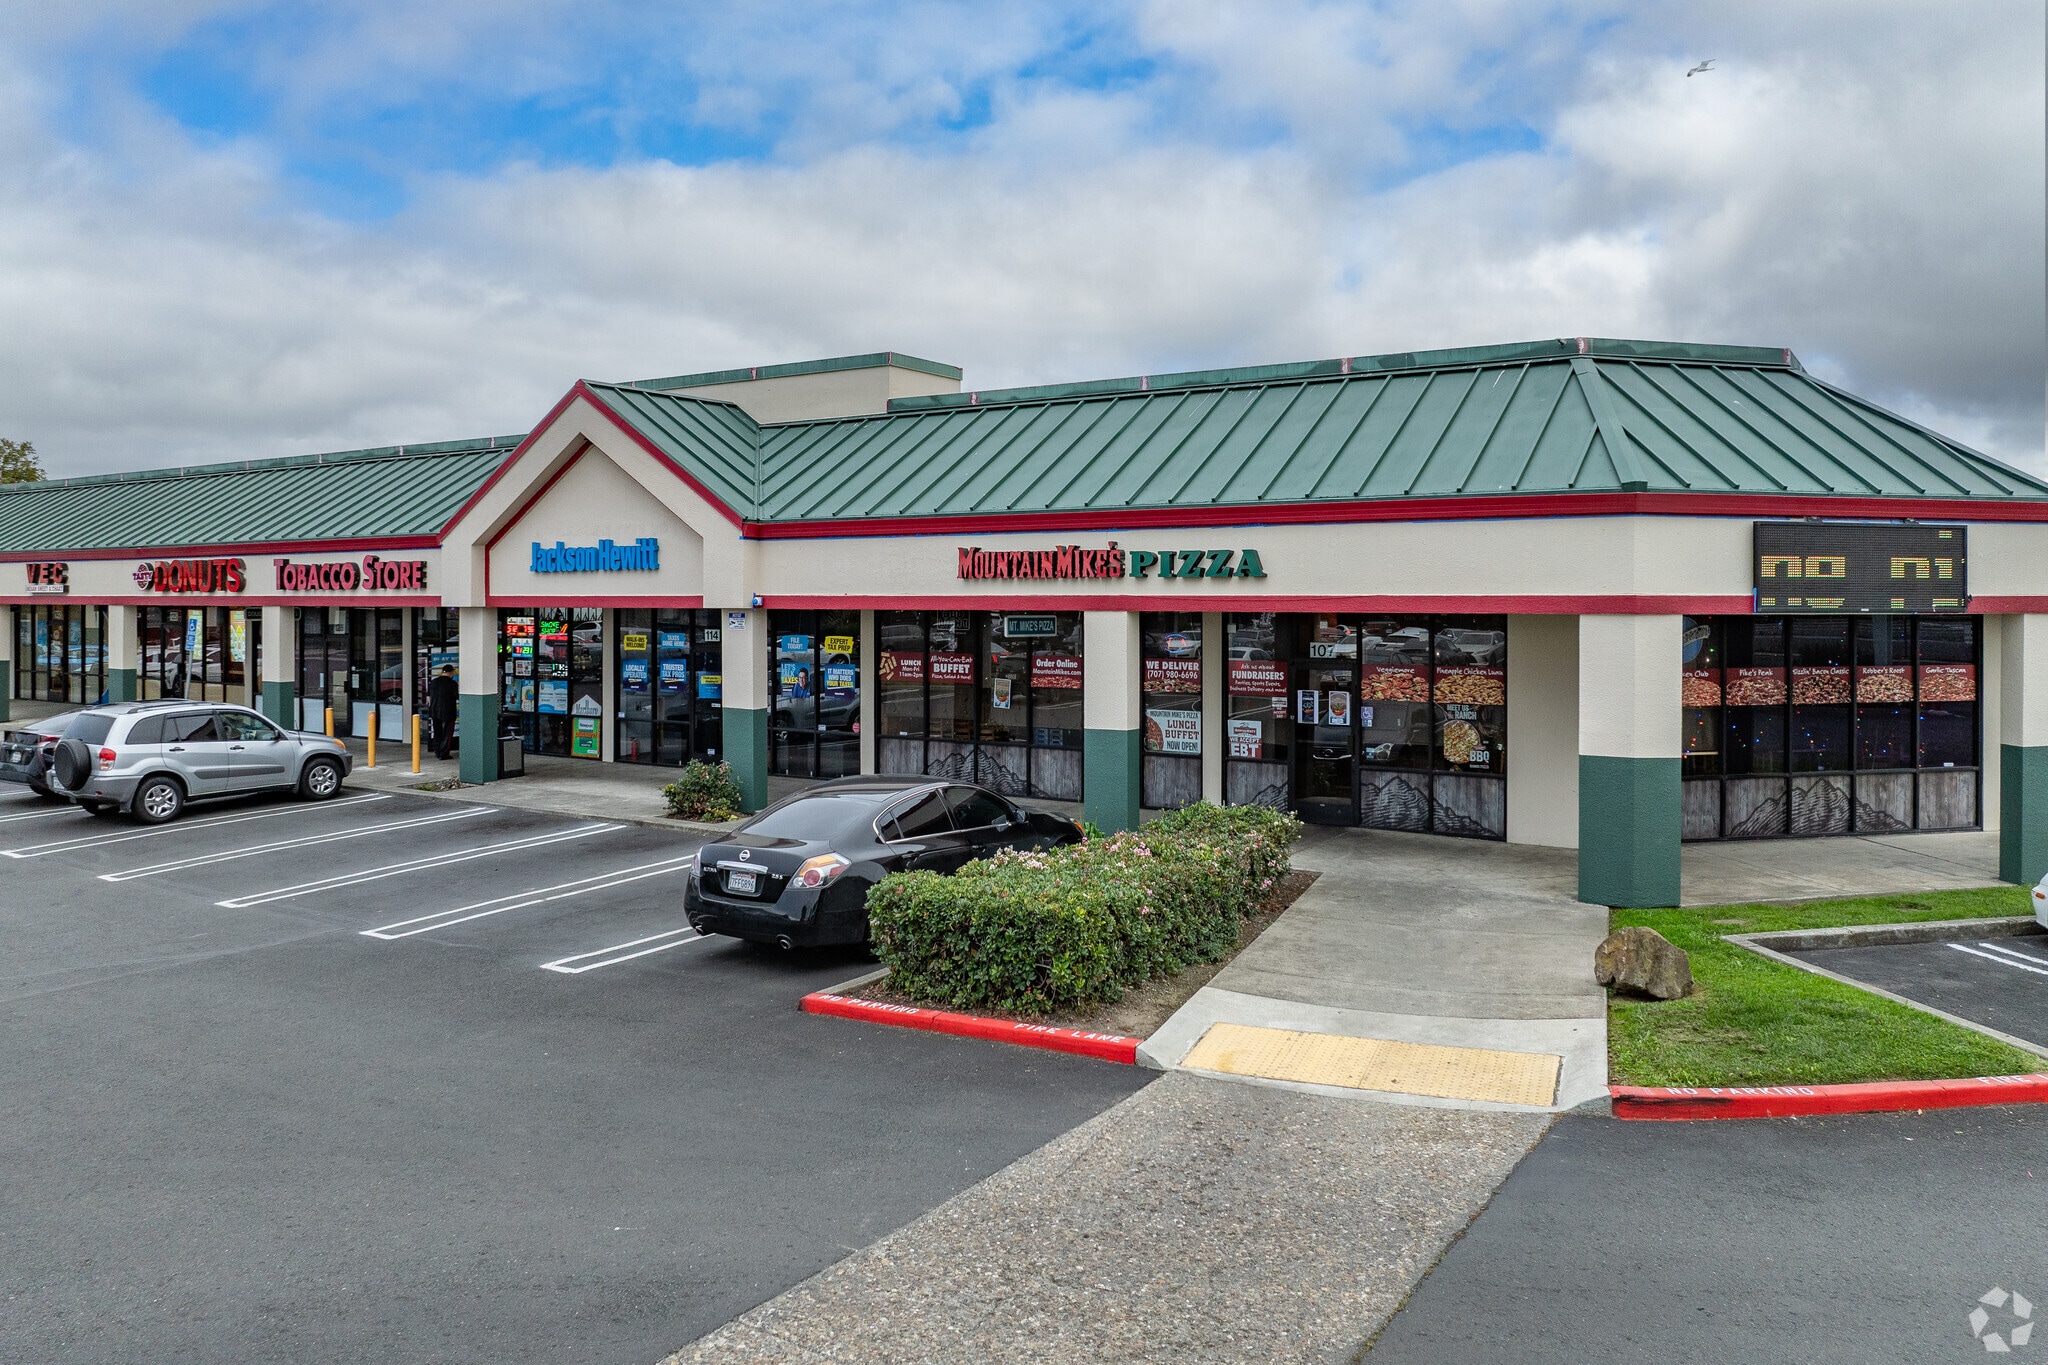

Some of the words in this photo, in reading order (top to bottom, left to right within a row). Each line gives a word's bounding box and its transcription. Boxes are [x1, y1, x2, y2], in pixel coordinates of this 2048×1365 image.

[530, 541, 599, 573] Jackson
[599, 537, 660, 571] Hewitt
[957, 546, 1055, 579] MOUNTAIN
[1055, 541, 1124, 579] MIKE'S
[1129, 549, 1267, 578] PIZZA
[154, 558, 245, 592] DONUTS
[273, 558, 358, 590] TOBACCO
[362, 554, 426, 590] STORE
[1008, 620, 1019, 631] MT.
[1020, 620, 1038, 631] MIKE'S
[1038, 620, 1055, 631] PIZZA
[705, 630, 719, 640] 114
[830, 637, 848, 645] EXPERT
[1311, 644, 1334, 657] 107
[625, 664, 646, 672] LOCALLY
[662, 663, 684, 671] TRUSTED
[781, 663, 796, 671] LET'S
[933, 663, 970, 674] BUFFET
[1036, 658, 1055, 667] Order
[1056, 658, 1078, 668] Online
[1146, 660, 1160, 670] WE
[1162, 661, 1200, 671] DELIVER
[623, 671, 647, 679] OPERATED
[833, 668, 854, 676] MATTERS
[1032, 668, 1082, 676] MountainMikes.com
[1147, 670, 1165, 679] (707)
[1166, 670, 1198, 679] 980-6696
[1231, 670, 1285, 681] FUNDRAISERS
[1376, 666, 1415, 674] Veggiemore
[1436, 667, 1462, 677] Pineapple
[1463, 667, 1487, 676] Chicken
[1830, 667, 1850, 675] Classic
[1150, 710, 1170, 718] MOUNTAIN
[1171, 711, 1186, 719] MIKE'S
[1454, 710, 1477, 720] RANCH
[1167, 719, 1197, 730] LUNCH
[1165, 729, 1200, 740] BUFFET
[1166, 740, 1180, 750] NOW
[1181, 741, 1199, 751] OPEN!
[1230, 743, 1259, 758] EBT
[1469, 750, 1490, 763] BBQ
[819, 994, 842, 1002] NO
[846, 997, 920, 1014] PARKING
[1013, 1022, 1061, 1035] FIRE
[1071, 1031, 1126, 1044] LANE
[1976, 1074, 2033, 1085] FIRE
[1665, 1087, 1699, 1095] NO
[1709, 1086, 1815, 1095] PARKING
